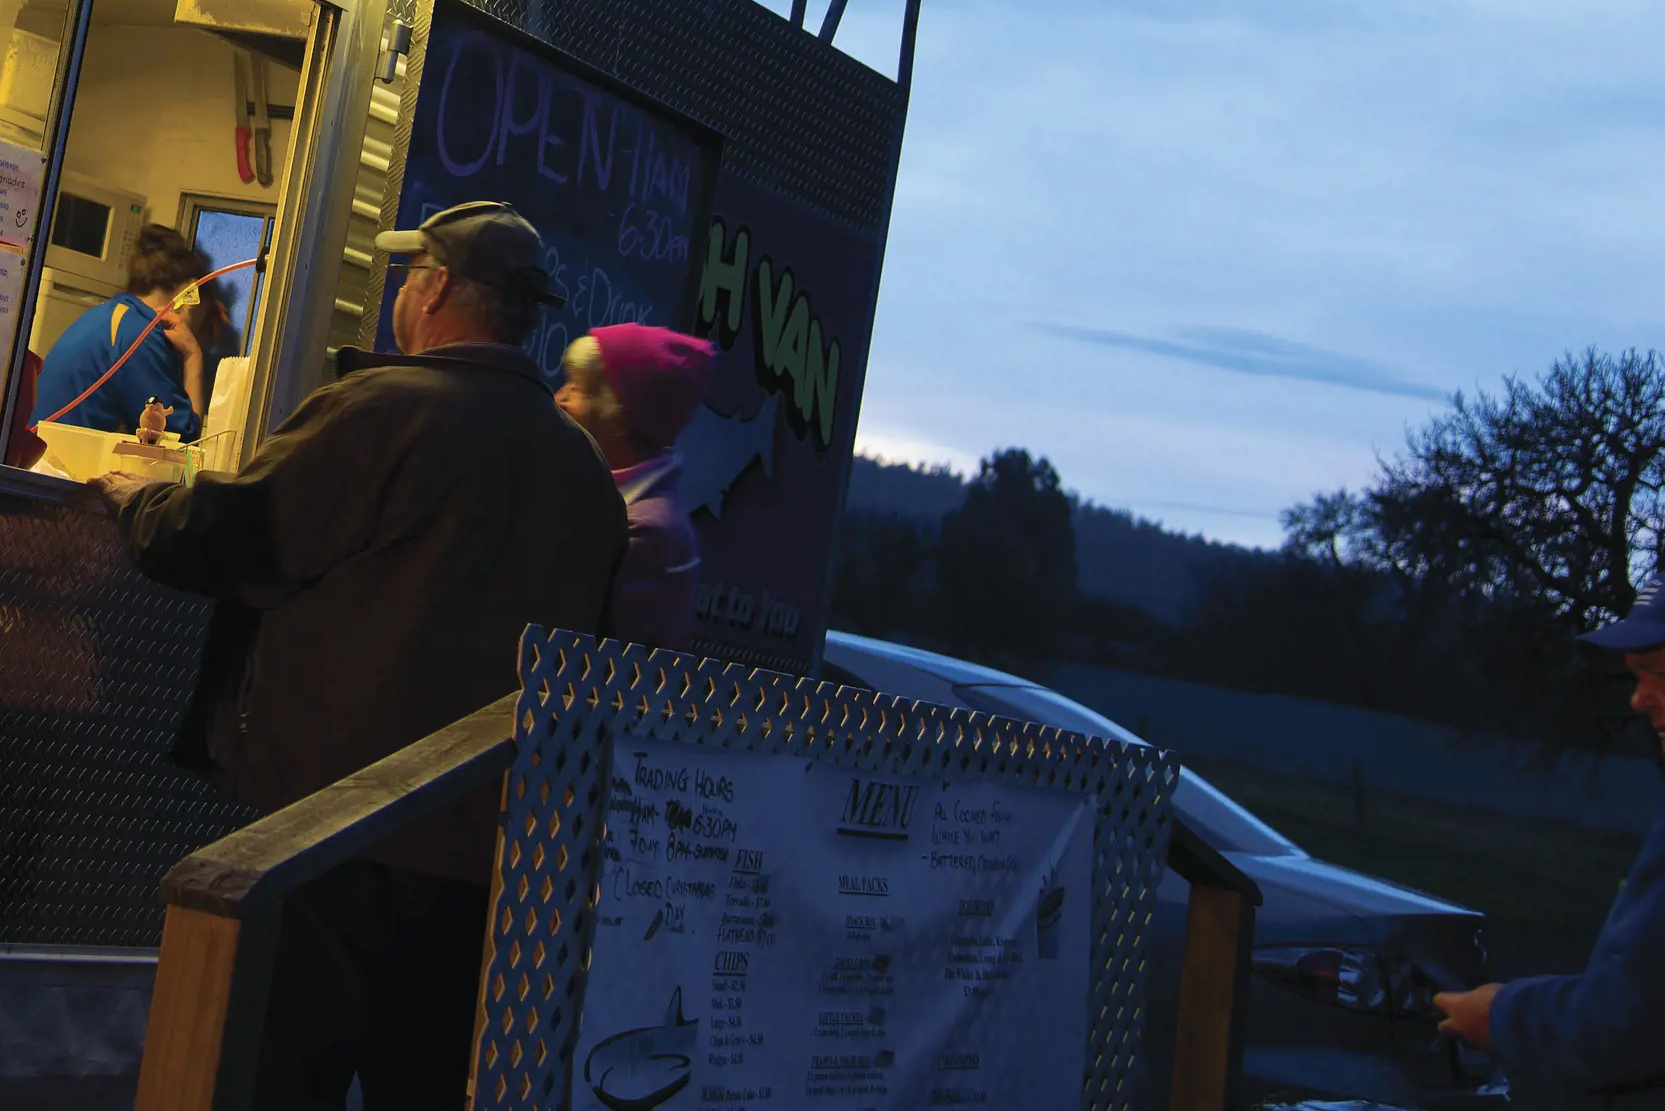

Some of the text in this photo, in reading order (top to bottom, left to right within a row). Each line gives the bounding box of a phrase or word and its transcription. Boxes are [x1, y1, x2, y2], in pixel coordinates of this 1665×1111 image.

[436, 30, 622, 193] OPEN
[752, 254, 840, 453] VAN
[633, 751, 734, 803] TRADING HOURS
[839, 777, 922, 830] MENU
[935, 800, 948, 821] ALL
[954, 799, 987, 825] COOKED
[932, 823, 960, 846] WHILE
[735, 849, 764, 871] FISH
[614, 865, 663, 902] CLOSED
[838, 875, 889, 893] MEAL PACKS
[665, 901, 686, 927] DAY
[714, 951, 750, 971] CHIPS
